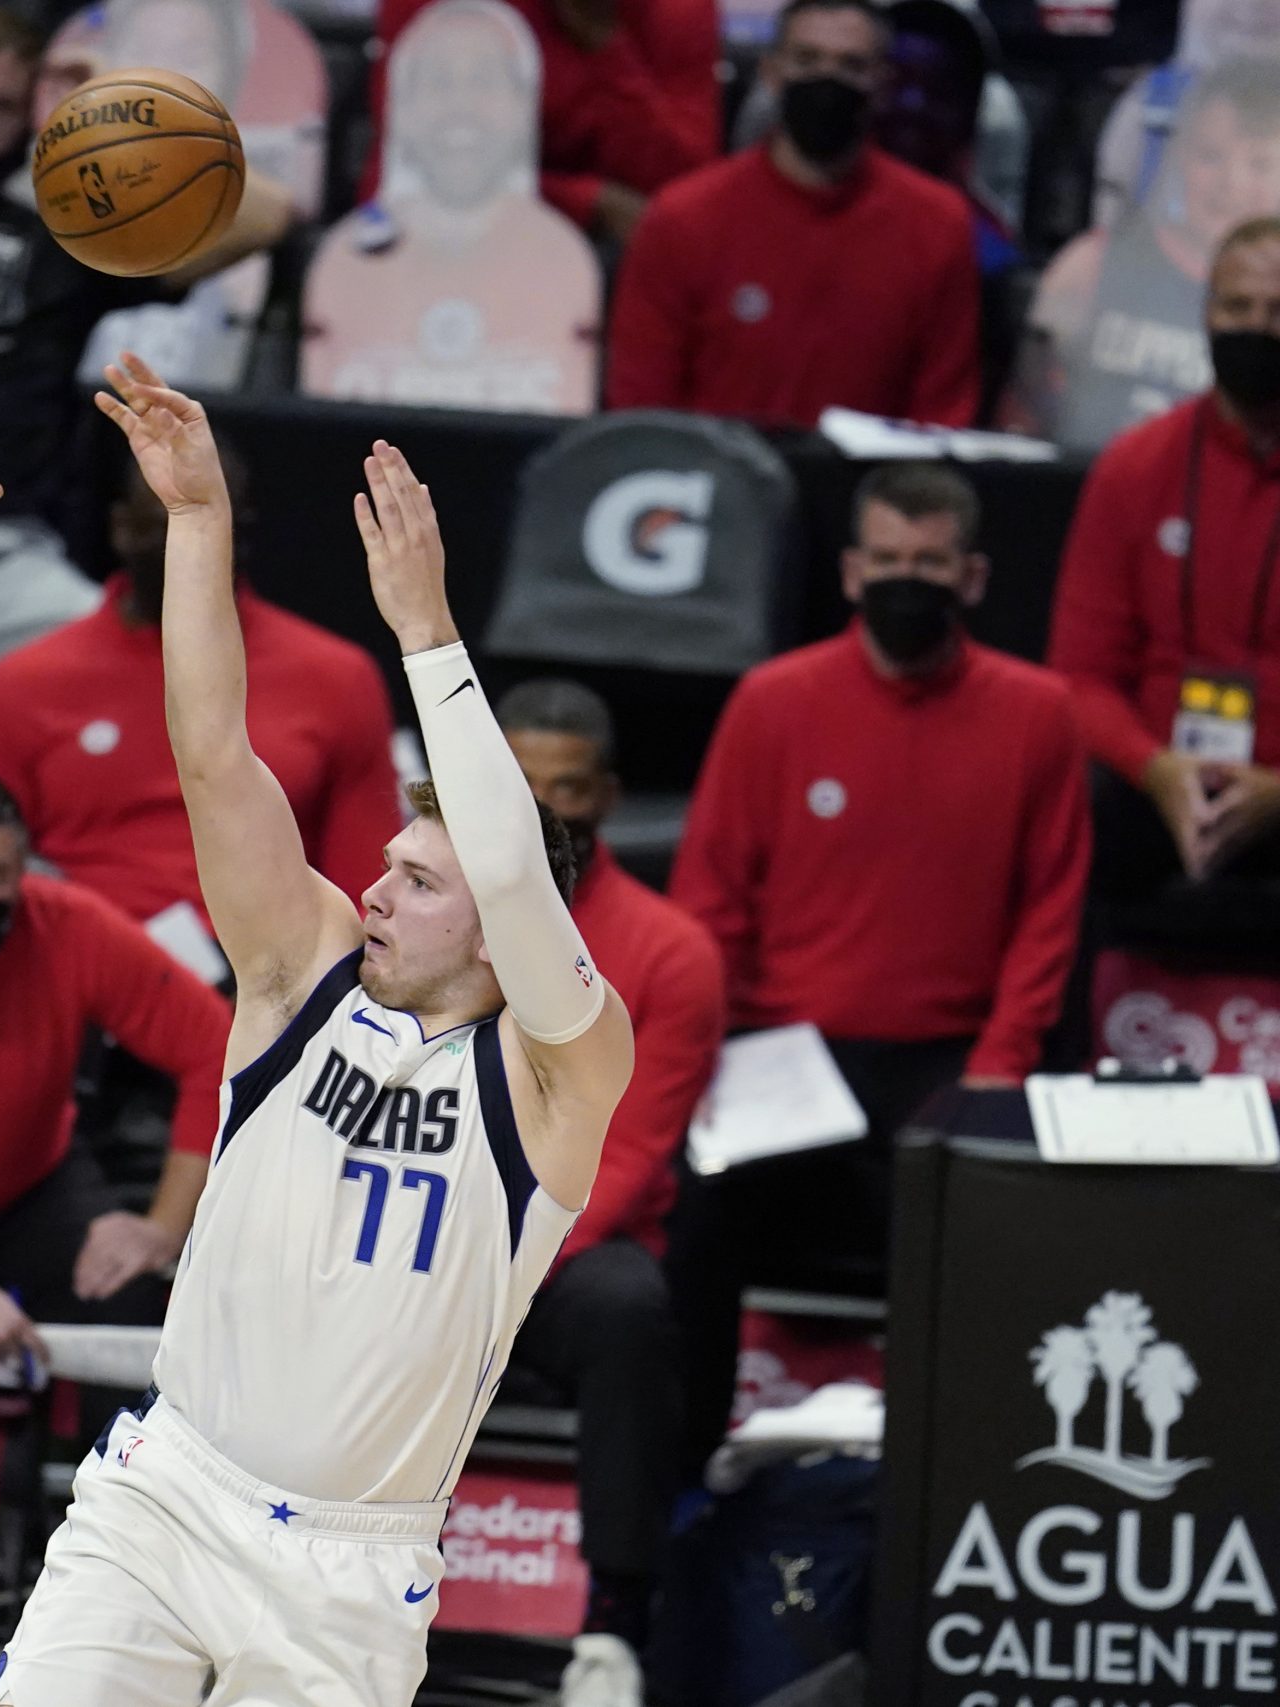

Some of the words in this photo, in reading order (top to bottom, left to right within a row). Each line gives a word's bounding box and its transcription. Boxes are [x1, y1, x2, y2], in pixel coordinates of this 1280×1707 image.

[582, 469, 715, 596] G
[299, 1046, 461, 1156] DALAS
[340, 1156, 450, 1276] 77
[932, 1501, 1277, 1616] AGUA
[926, 1612, 1279, 1693] CALIENTE
